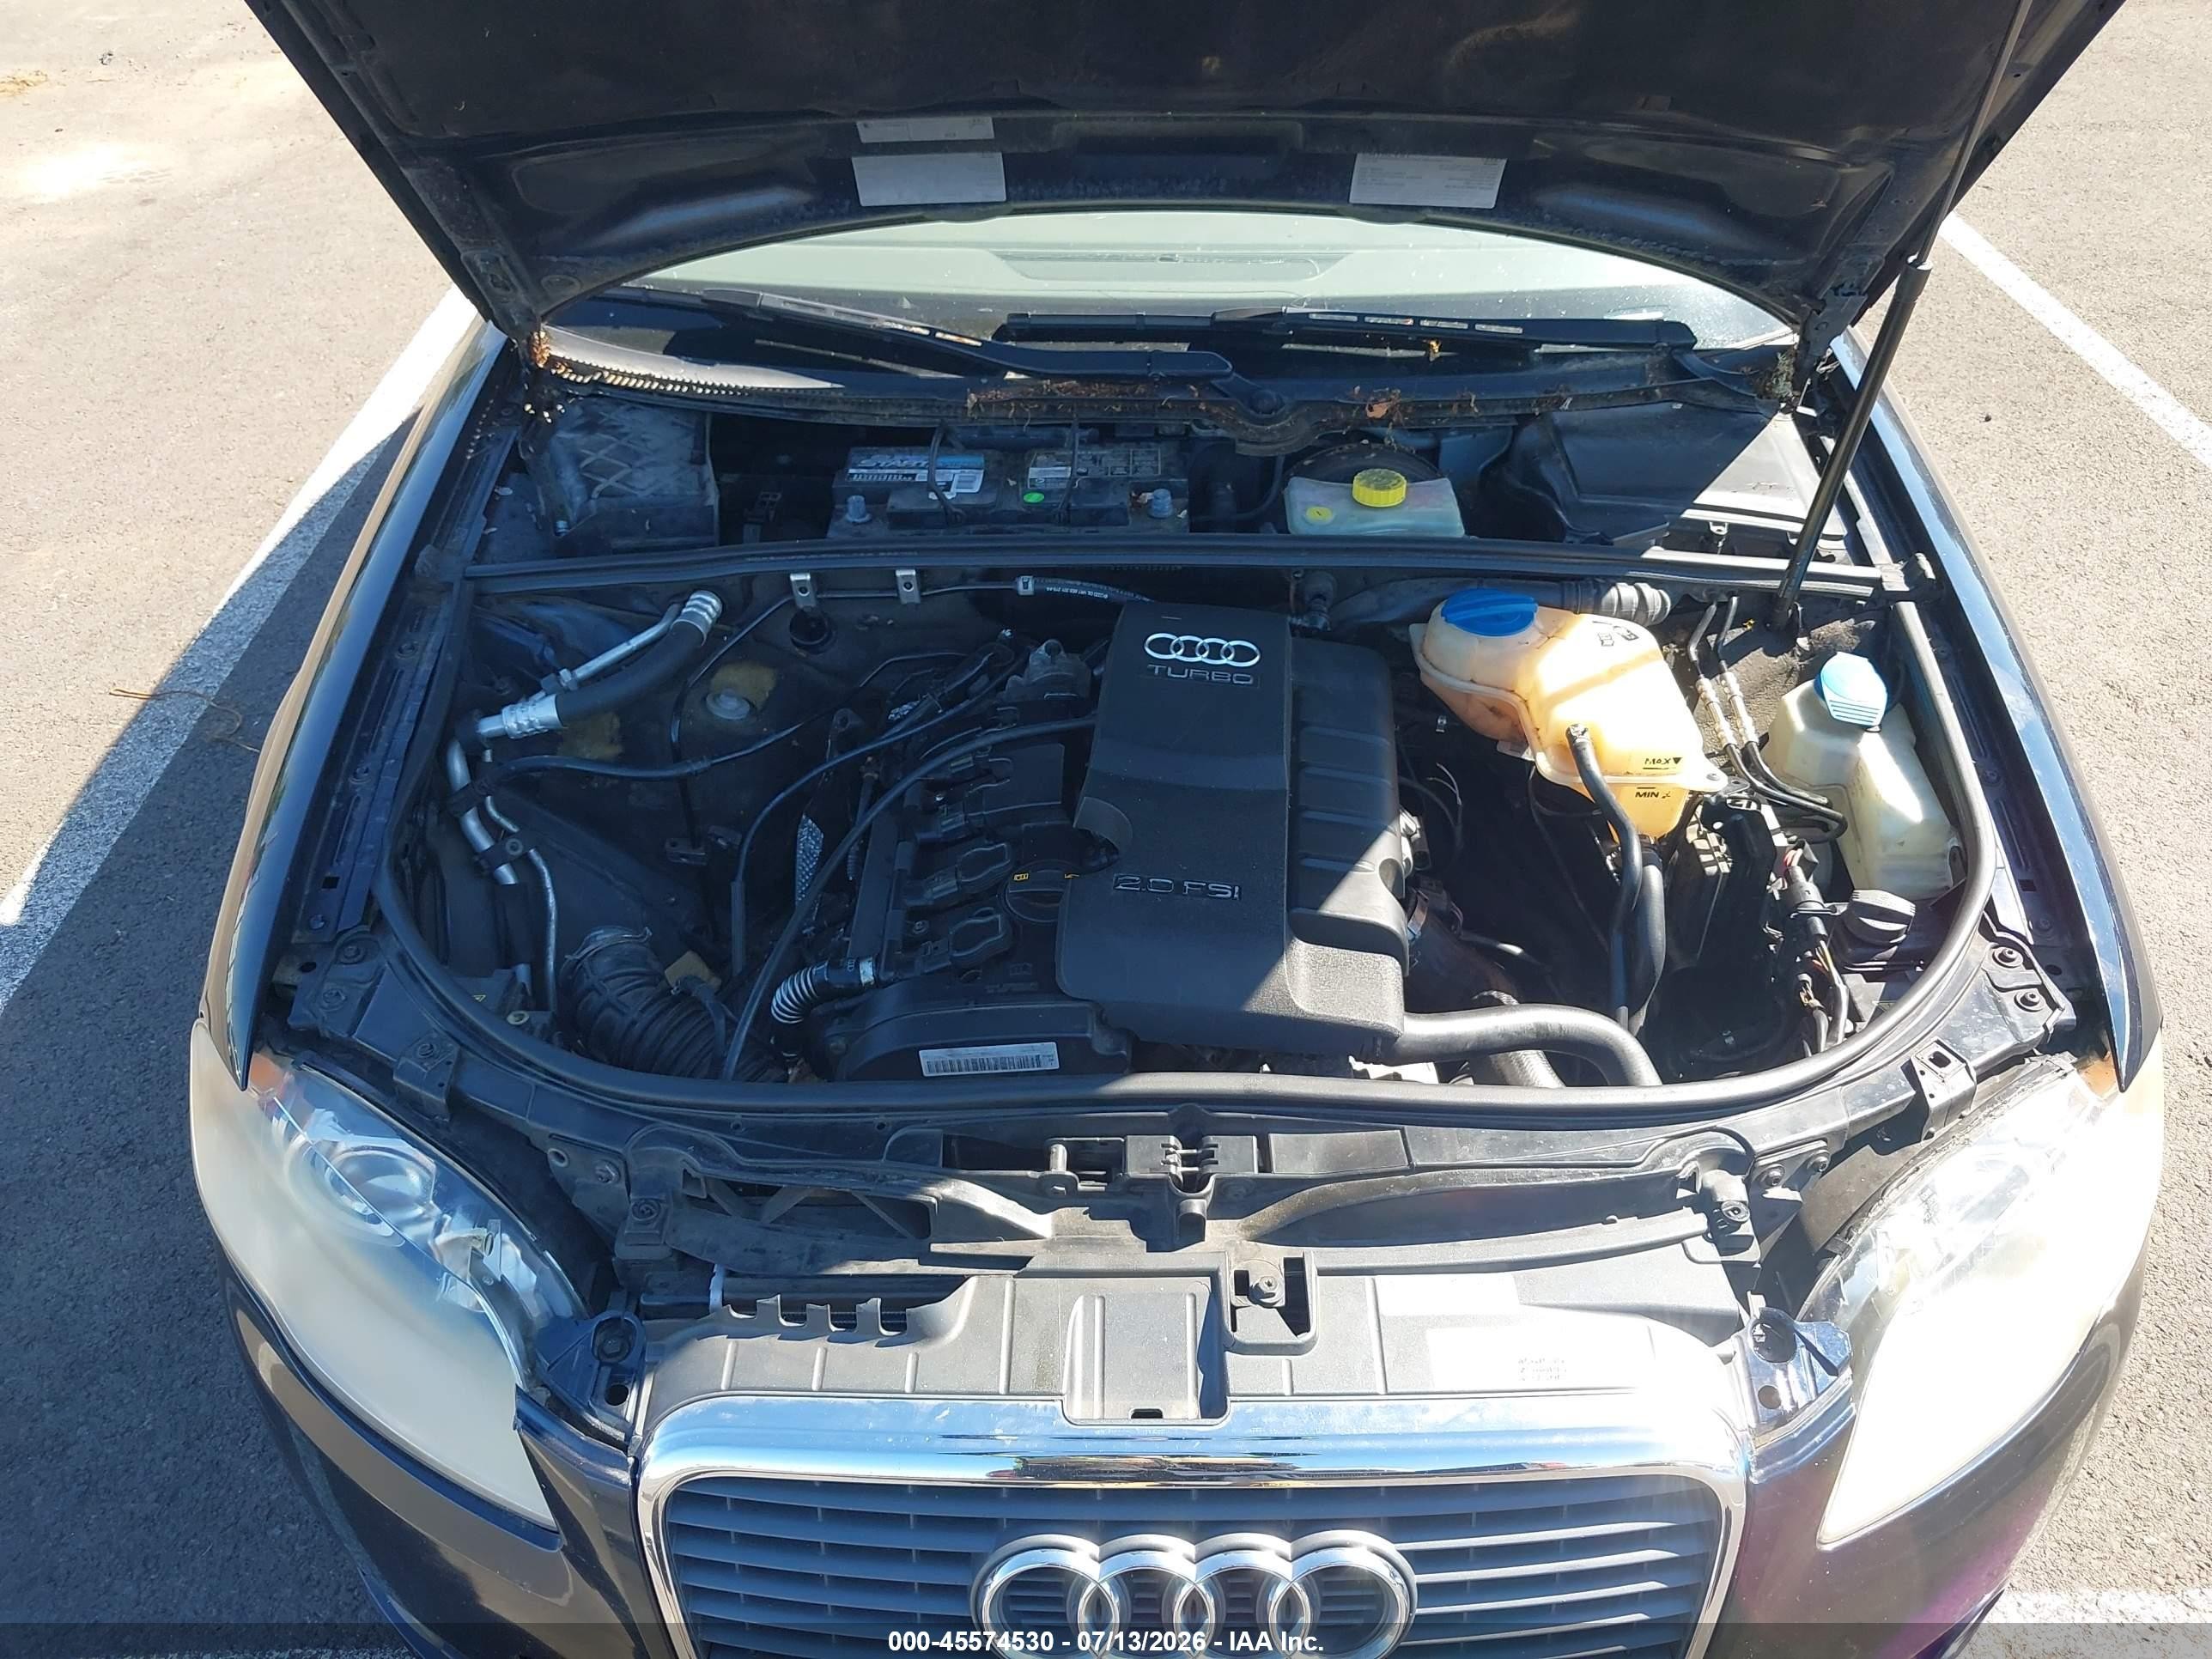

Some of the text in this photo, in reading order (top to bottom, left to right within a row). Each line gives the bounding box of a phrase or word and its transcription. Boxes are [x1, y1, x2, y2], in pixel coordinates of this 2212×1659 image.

[1147, 664, 1254, 684] TURBO
[1115, 876, 1240, 900] 2.0 FSI
